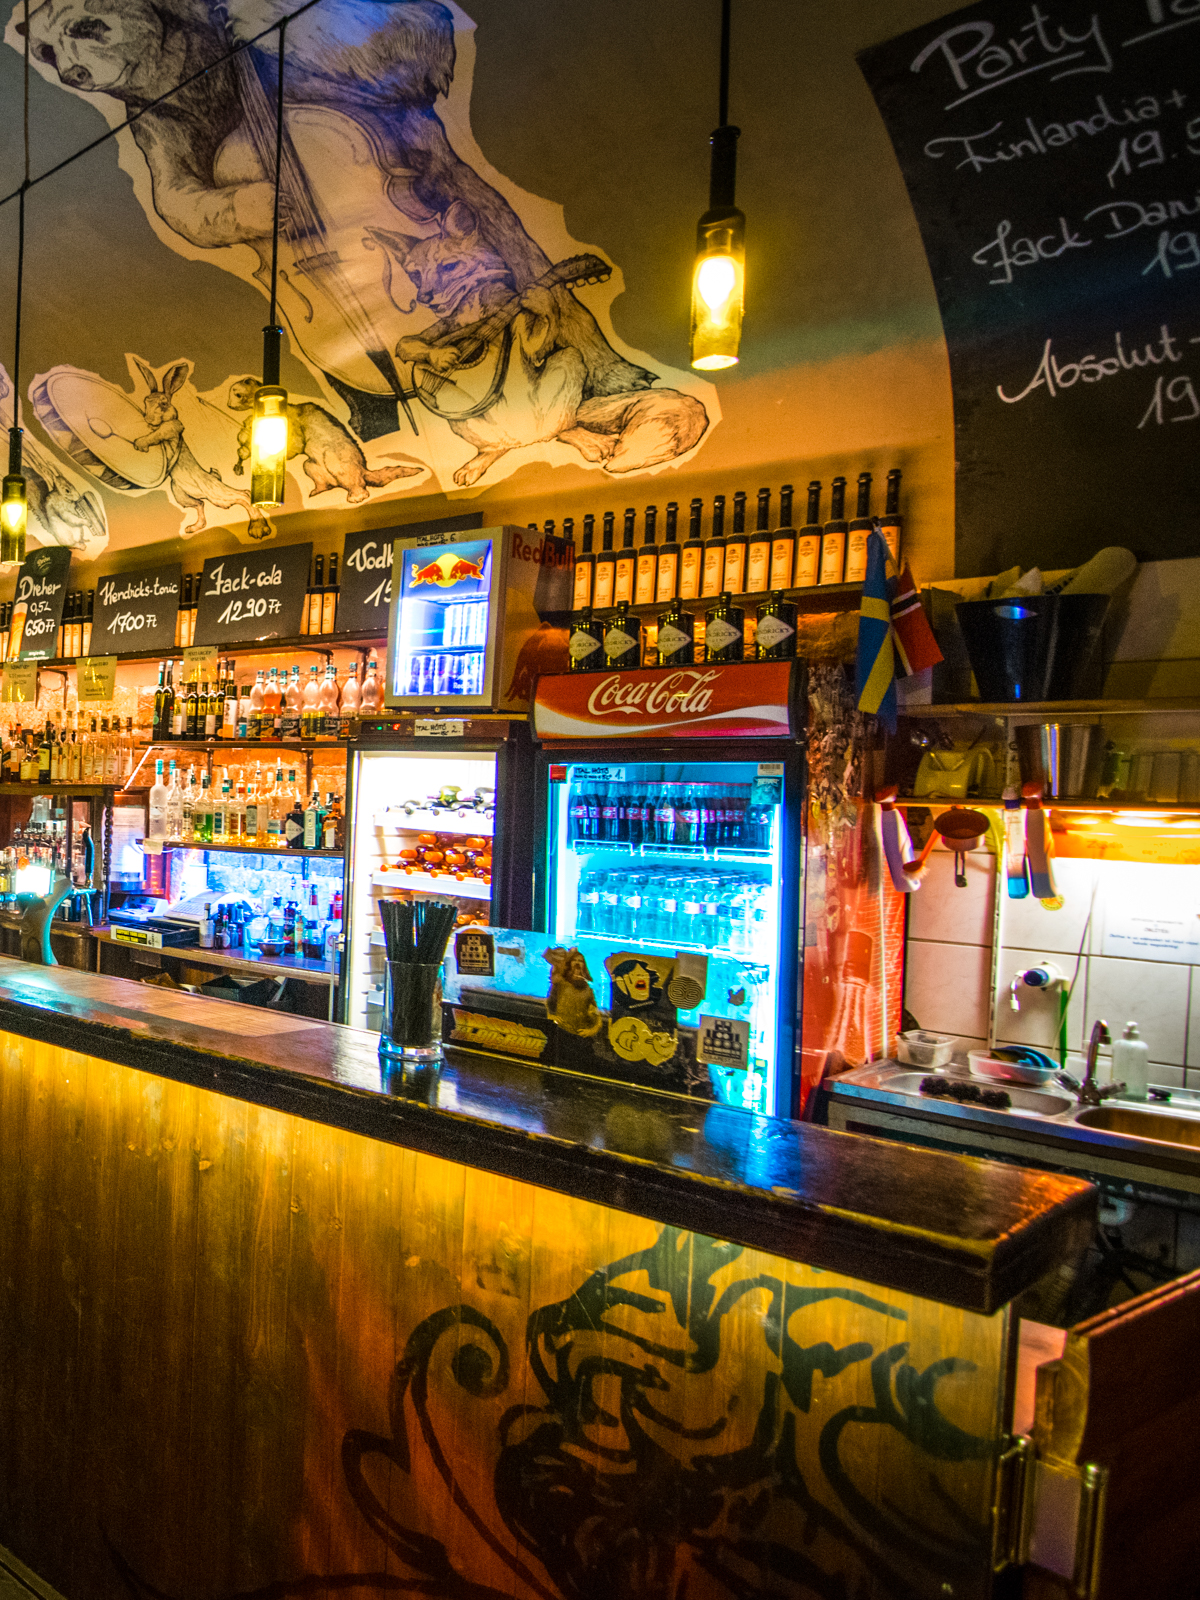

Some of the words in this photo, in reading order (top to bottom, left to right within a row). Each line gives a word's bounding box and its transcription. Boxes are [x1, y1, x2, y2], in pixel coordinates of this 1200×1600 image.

[910, 4, 1113, 91] Party
[972, 217, 1092, 285] Jack
[997, 324, 1182, 404] Absolut
[16, 575, 62, 604] Dreher
[588, 669, 725, 716] Coca-Cola
